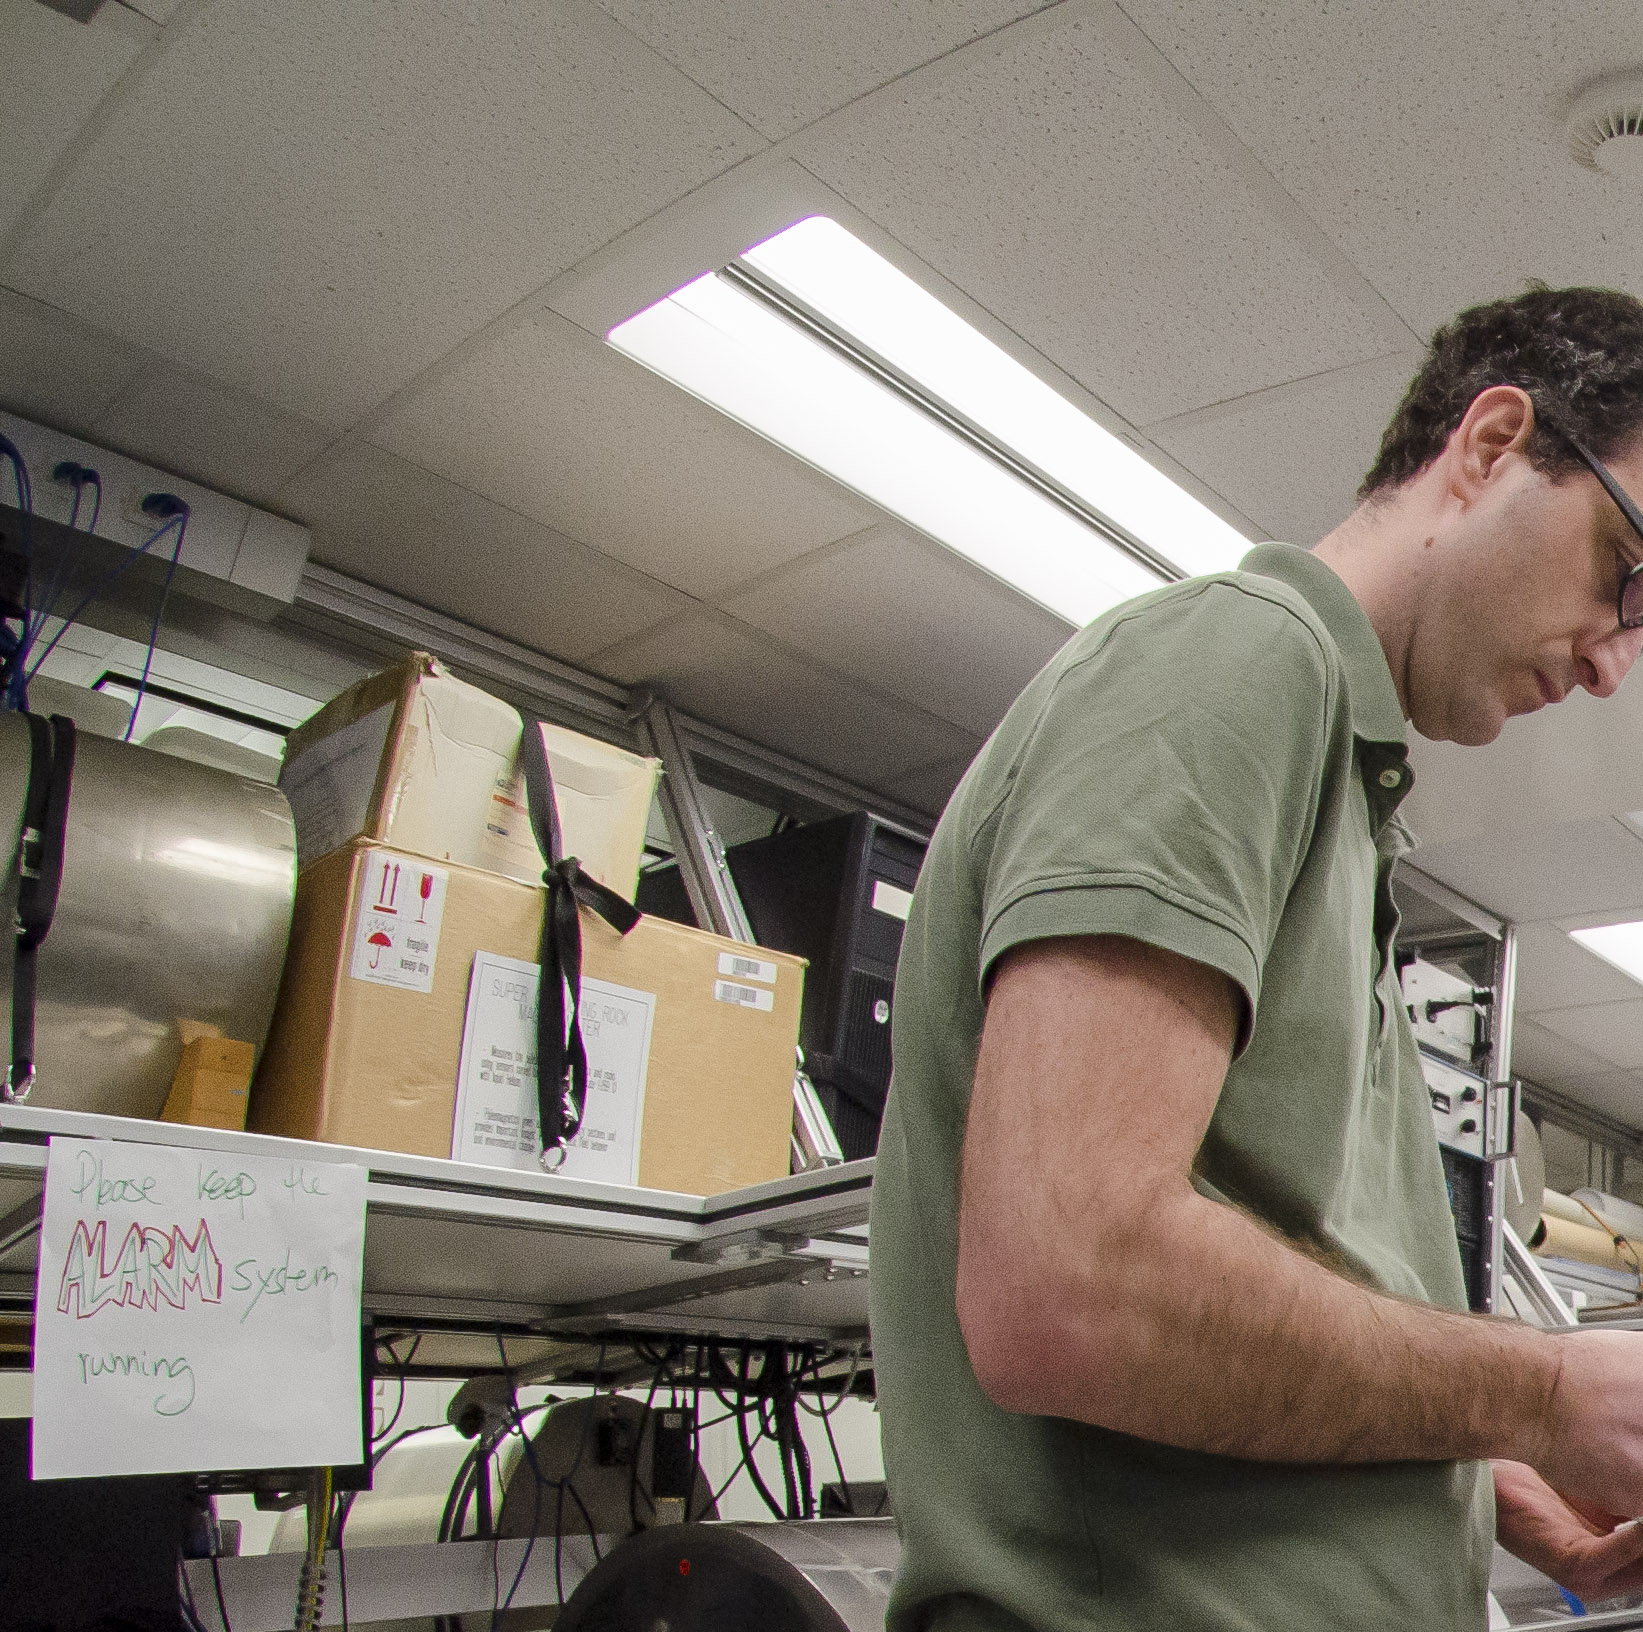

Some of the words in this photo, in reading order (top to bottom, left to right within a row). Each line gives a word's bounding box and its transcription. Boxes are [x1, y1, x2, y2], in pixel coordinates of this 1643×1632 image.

[491, 978, 529, 1002] SUPER
[602, 1005, 629, 1027] ROCK
[71, 1149, 164, 1211] Please
[284, 1163, 328, 1197] the
[57, 1218, 222, 1319] ALARM
[78, 1350, 196, 1416] running
